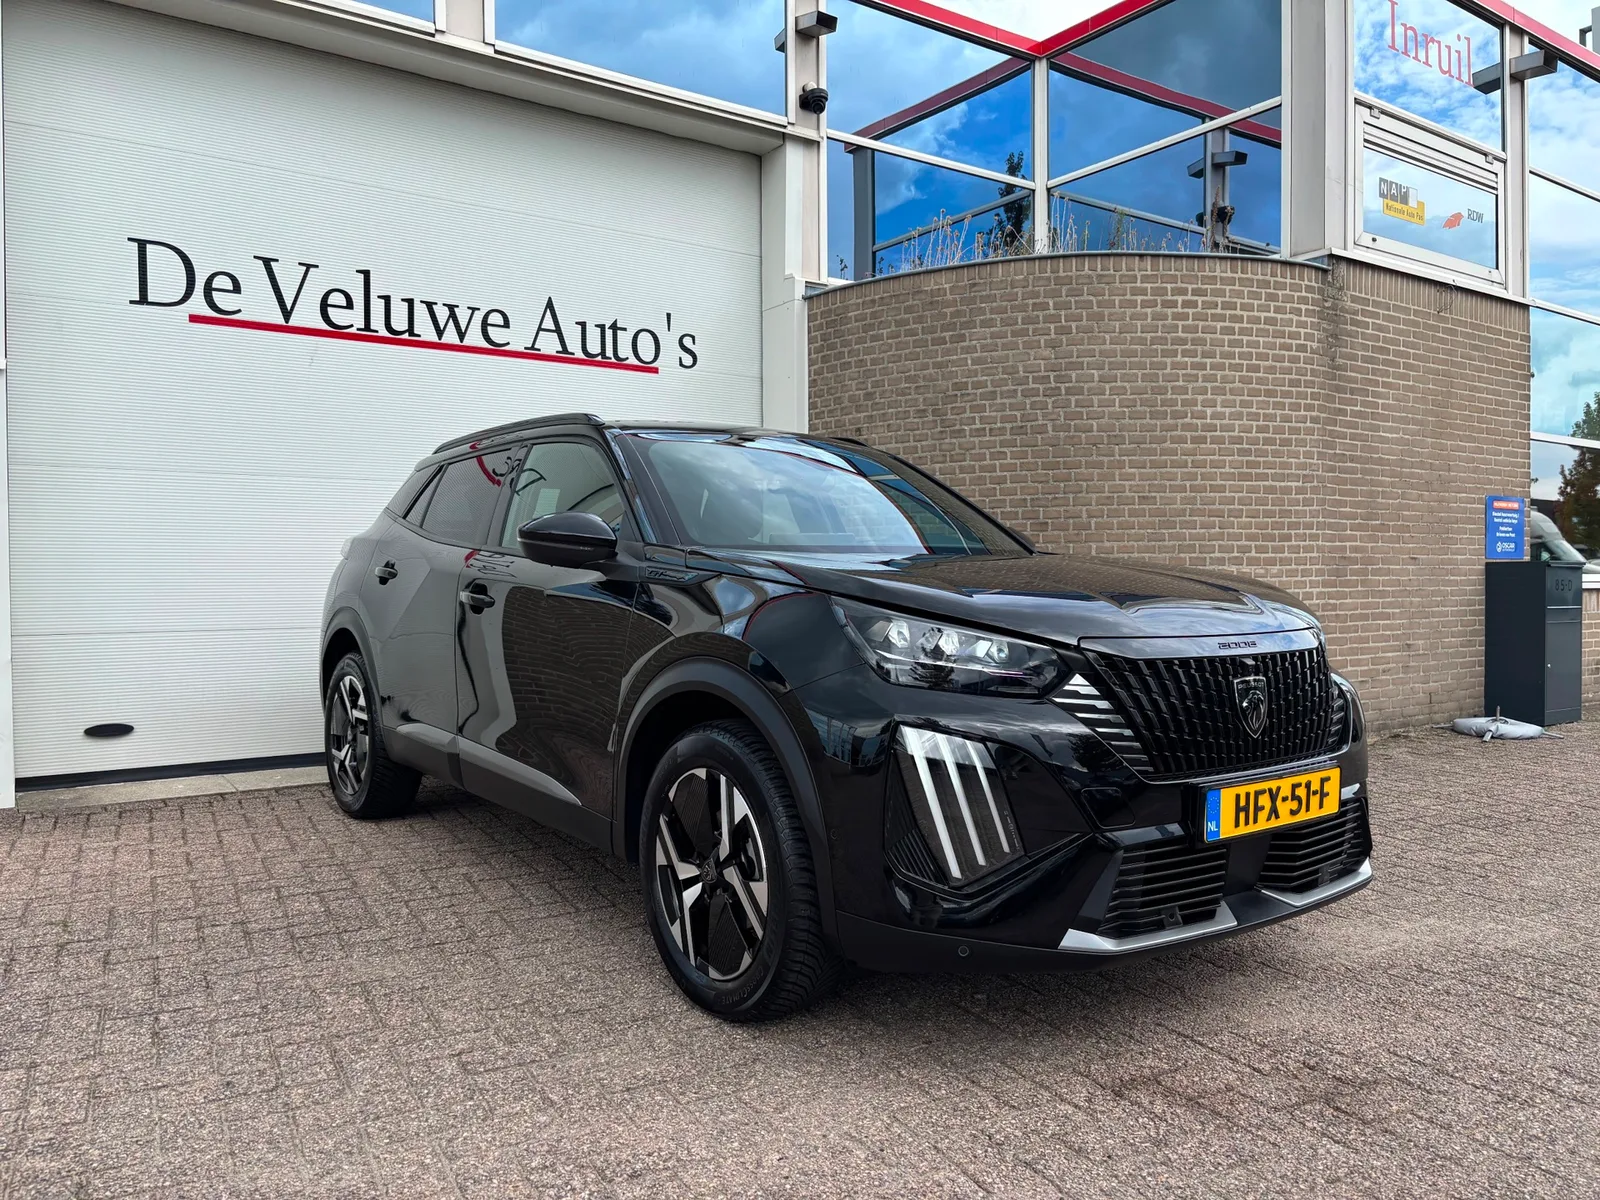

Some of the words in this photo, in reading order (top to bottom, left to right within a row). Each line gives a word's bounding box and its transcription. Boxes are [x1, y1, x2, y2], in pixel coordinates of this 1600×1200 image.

[1387, 0, 1474, 88] Inruil
[1380, 181, 1407, 197] NAP
[1467, 208, 1484, 223] RDW
[127, 237, 242, 317] De
[253, 255, 511, 349] Veluwe
[524, 296, 699, 369] Auto's
[1234, 775, 1331, 829] HFX-51-F
[1207, 820, 1219, 832] NL
